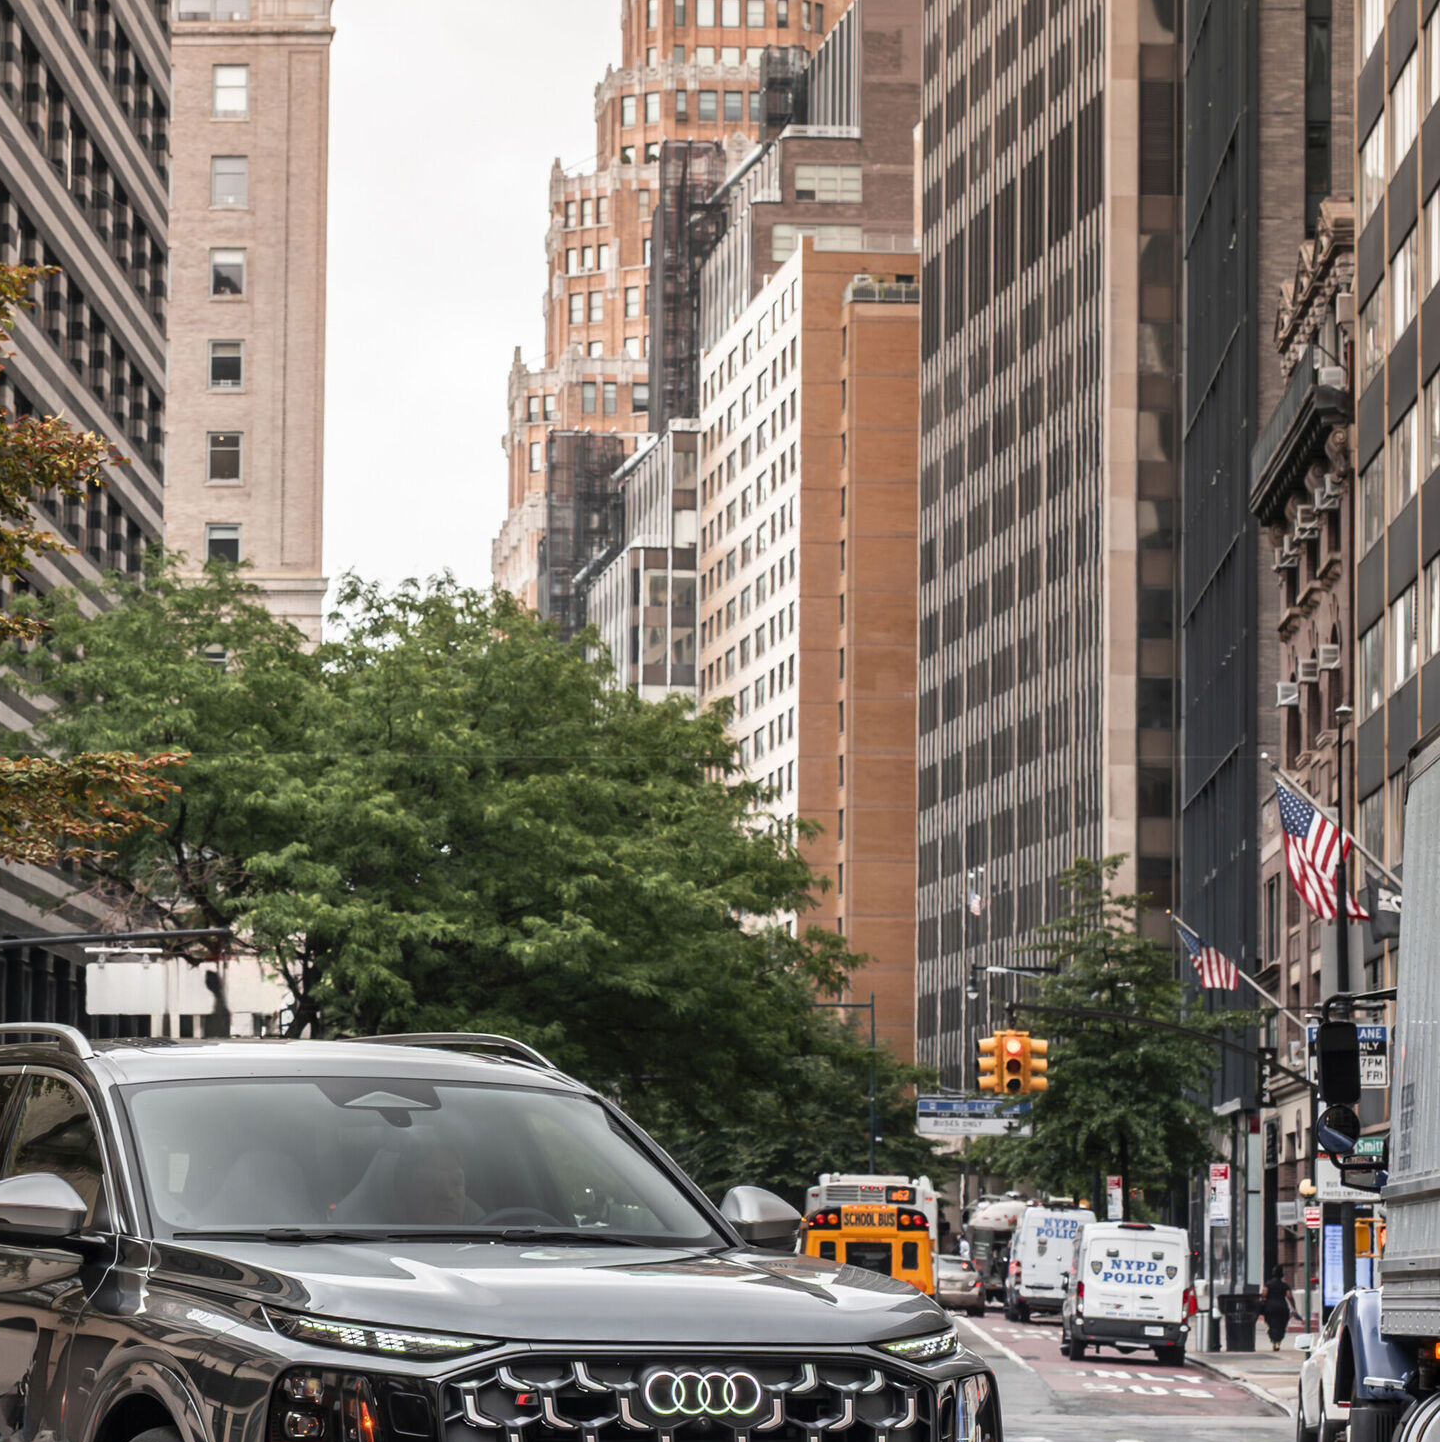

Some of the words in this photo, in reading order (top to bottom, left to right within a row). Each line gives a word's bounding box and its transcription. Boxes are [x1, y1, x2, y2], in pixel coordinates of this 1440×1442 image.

[1358, 1028, 1383, 1040] ANE
[1359, 1041, 1380, 1051] NLY
[844, 1212, 875, 1227] SCHOOL
[878, 1212, 896, 1227] BUS
[1043, 1218, 1078, 1229] NYPD
[1036, 1228, 1076, 1239] POLIC
[1111, 1260, 1158, 1272] NYPD
[1103, 1272, 1165, 1286] POLICE
